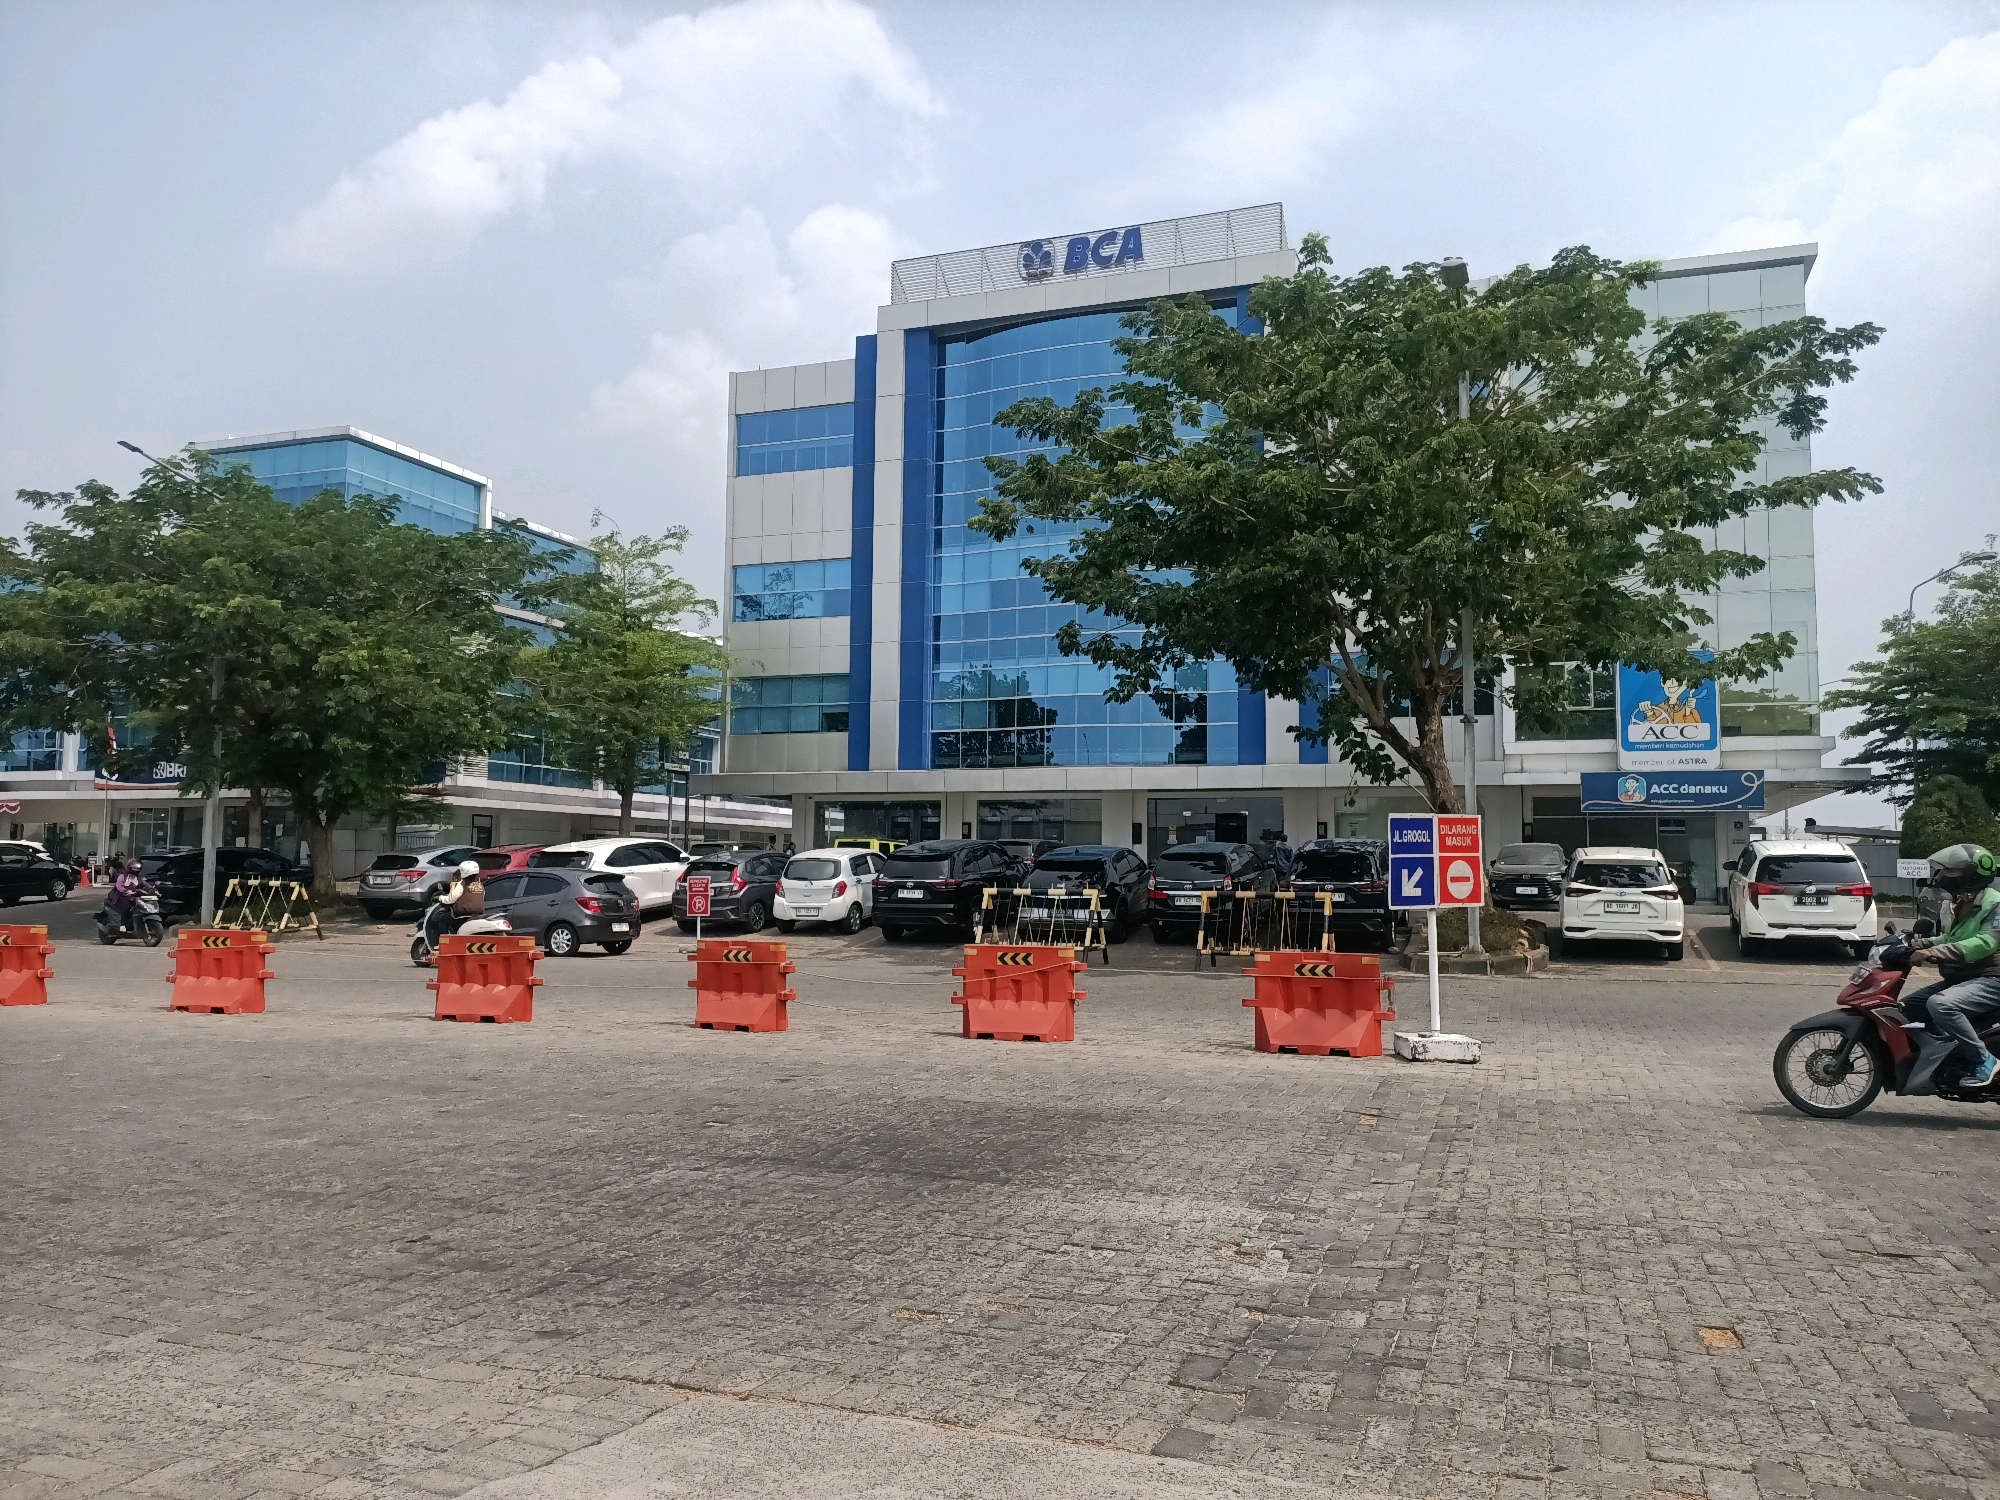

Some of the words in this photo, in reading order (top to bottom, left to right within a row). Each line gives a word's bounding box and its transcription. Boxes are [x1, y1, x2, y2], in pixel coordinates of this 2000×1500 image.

[1063, 227, 1144, 273] BCA
[1641, 725, 1699, 740] ACC
[1634, 742, 1665, 750] memberi
[1649, 783, 1679, 794] ACC
[1680, 783, 1728, 794] danaku
[1440, 824, 1477, 835] DILARANG
[1393, 829, 1431, 843] JL.GROGOL
[1445, 836, 1472, 847] MASUK
